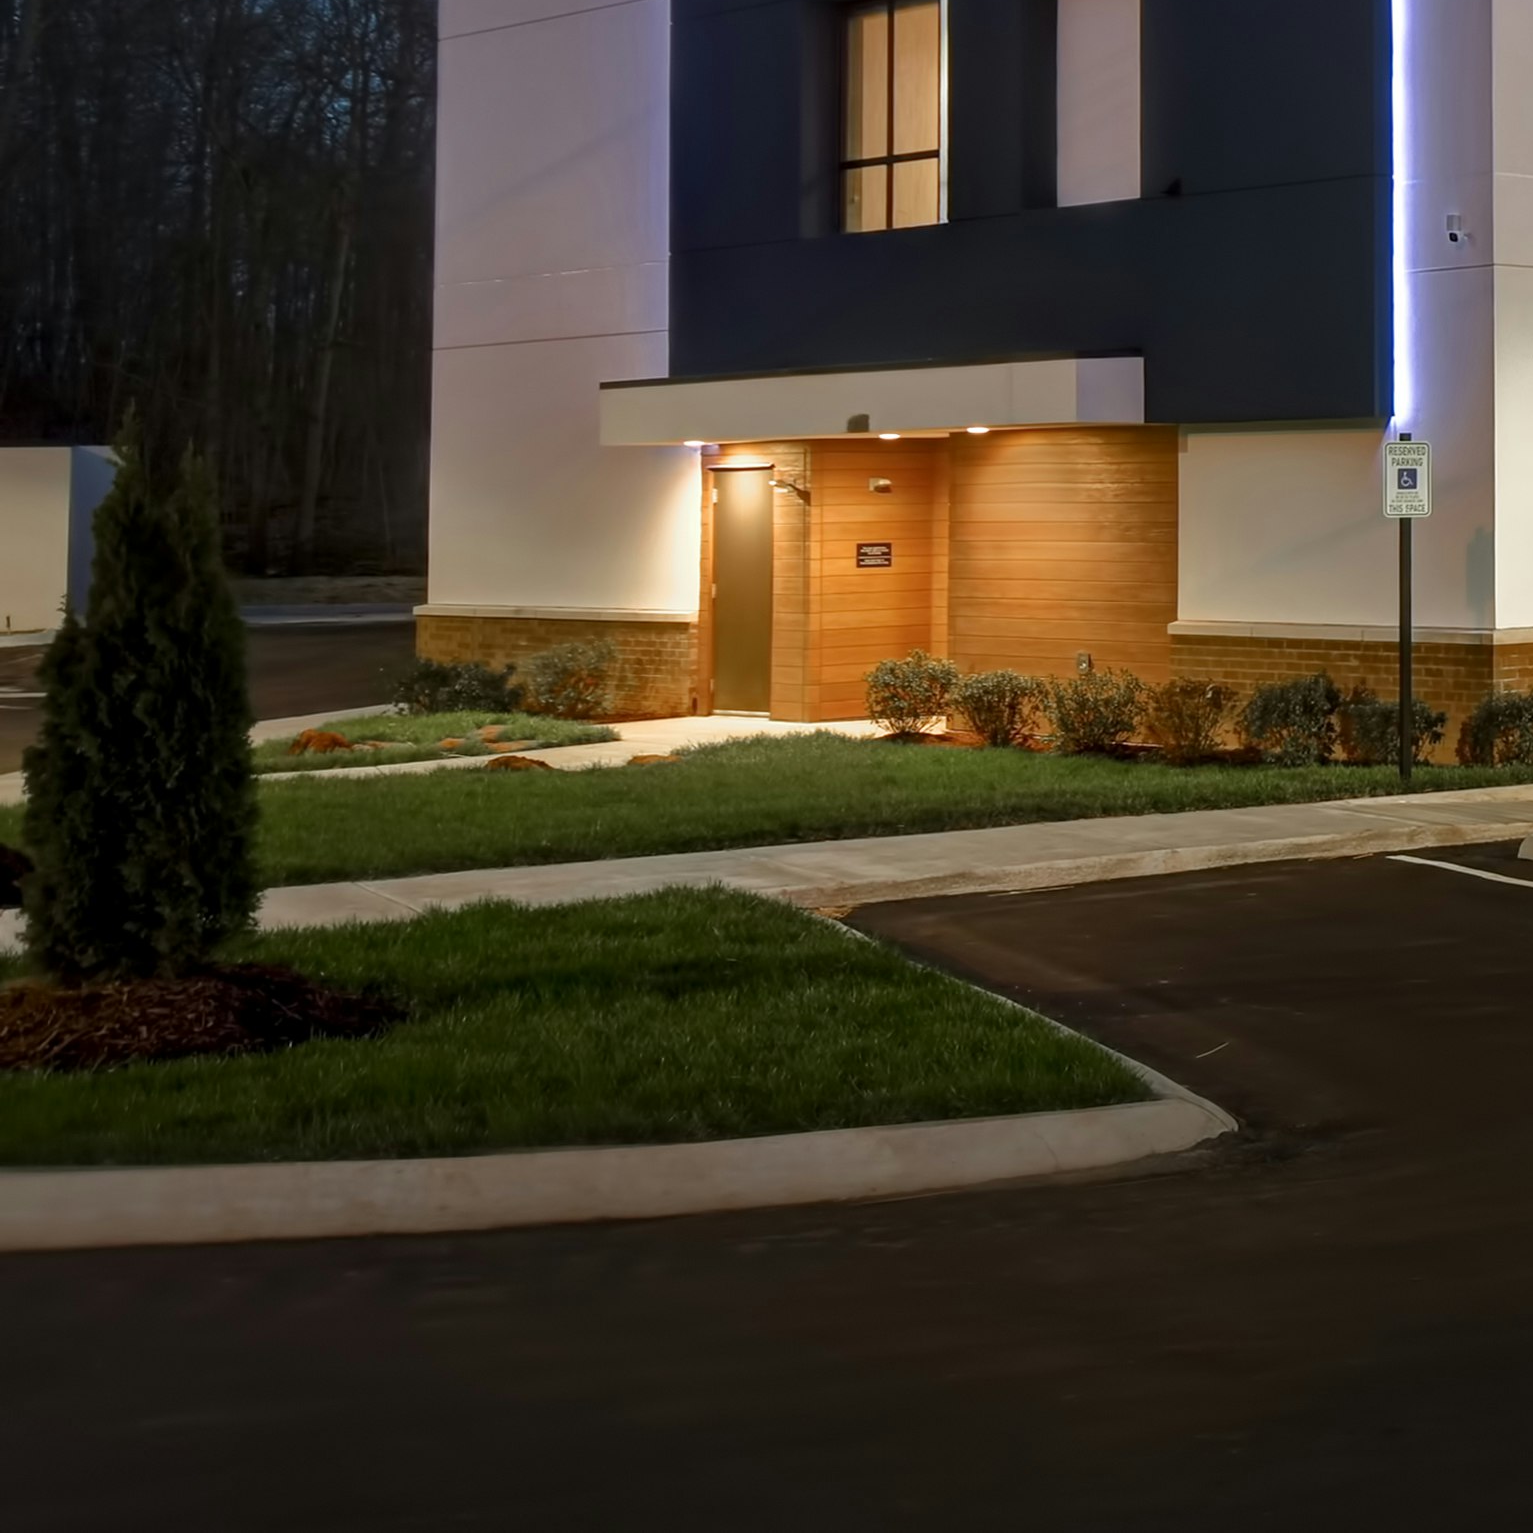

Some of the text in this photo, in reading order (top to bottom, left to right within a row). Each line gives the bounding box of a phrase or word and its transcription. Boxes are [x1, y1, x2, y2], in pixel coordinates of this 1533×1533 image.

[1388, 446, 1426, 456] RESERVED
[1391, 457, 1424, 467] PARKING
[1388, 504, 1426, 513] THIS SPACE
